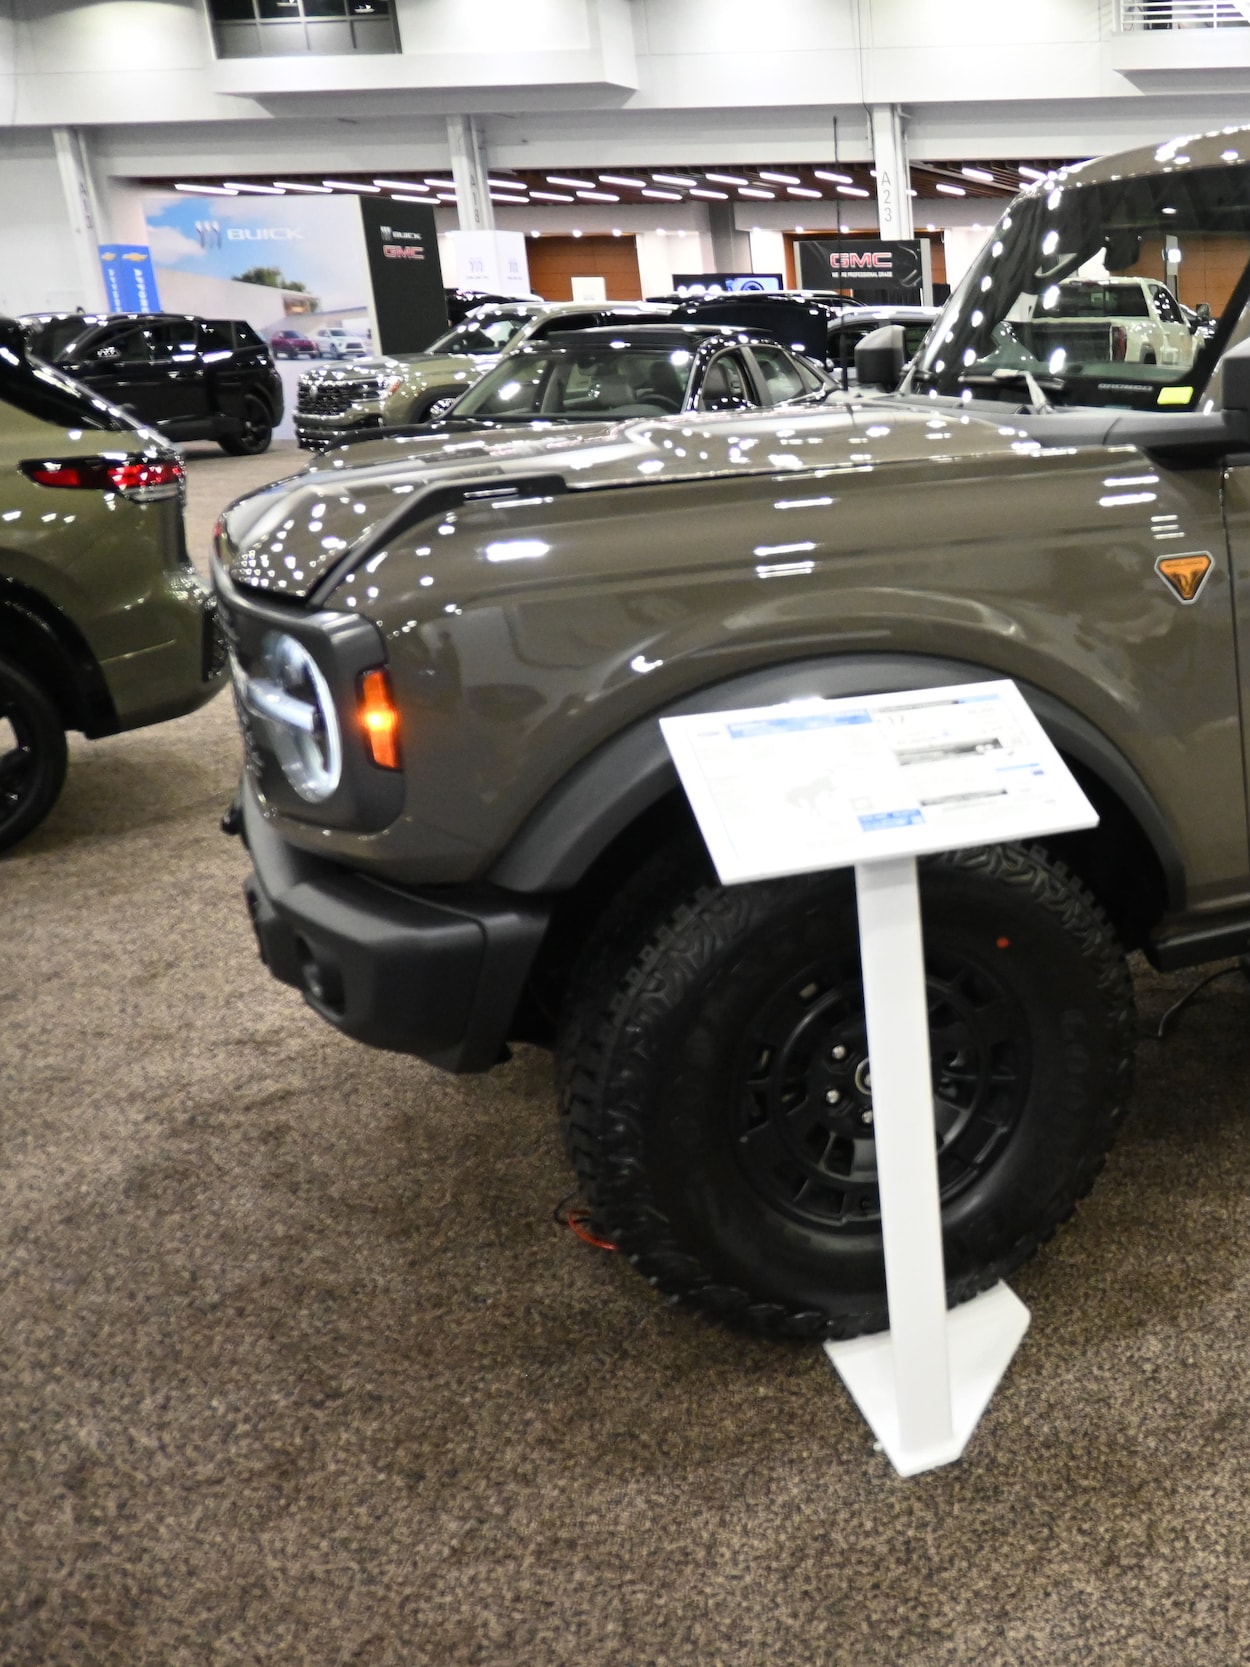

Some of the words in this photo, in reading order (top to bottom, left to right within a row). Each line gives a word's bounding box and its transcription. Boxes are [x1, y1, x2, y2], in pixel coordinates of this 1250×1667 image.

[227, 228, 304, 241] BUICK
[382, 244, 425, 260] GMC
[829, 252, 893, 268] GMC
